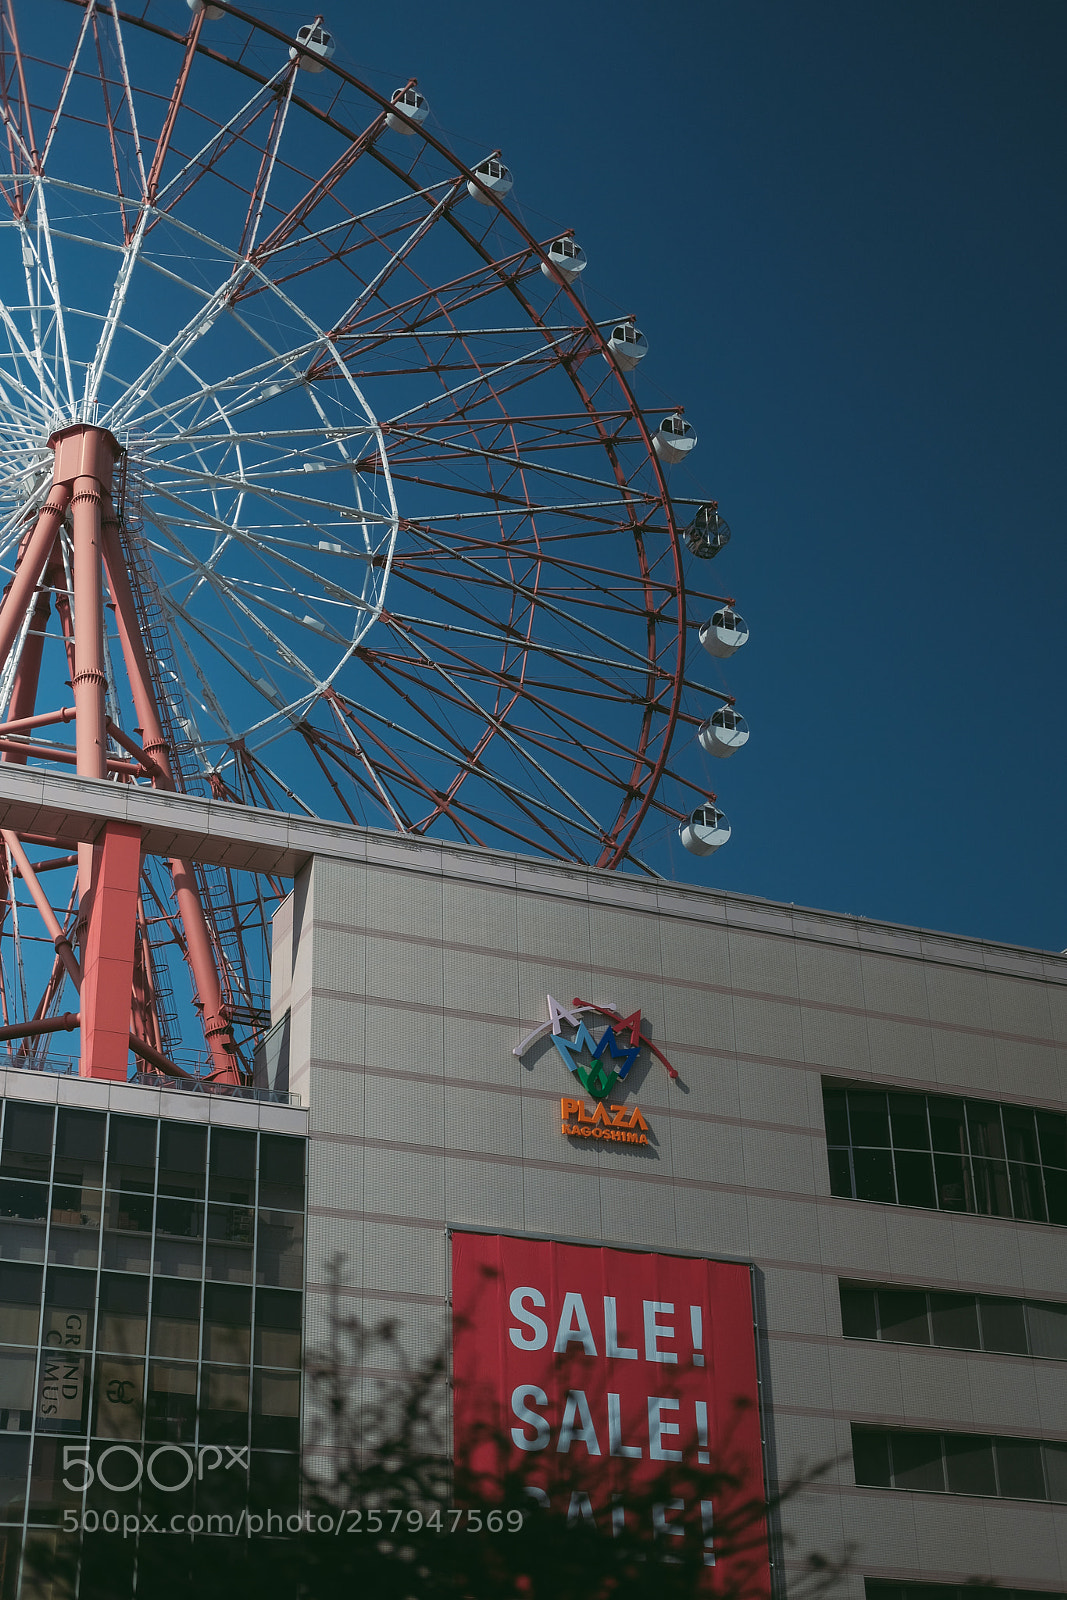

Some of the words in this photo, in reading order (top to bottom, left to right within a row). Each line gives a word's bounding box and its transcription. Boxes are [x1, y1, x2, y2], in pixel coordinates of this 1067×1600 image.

[561, 1098, 649, 1131] PLAZA
[561, 1123, 649, 1145] KAGOSHIMA
[508, 1286, 705, 1367] SALE!
[41, 1330, 63, 1415] CMUS
[510, 1384, 711, 1464] SALE!
